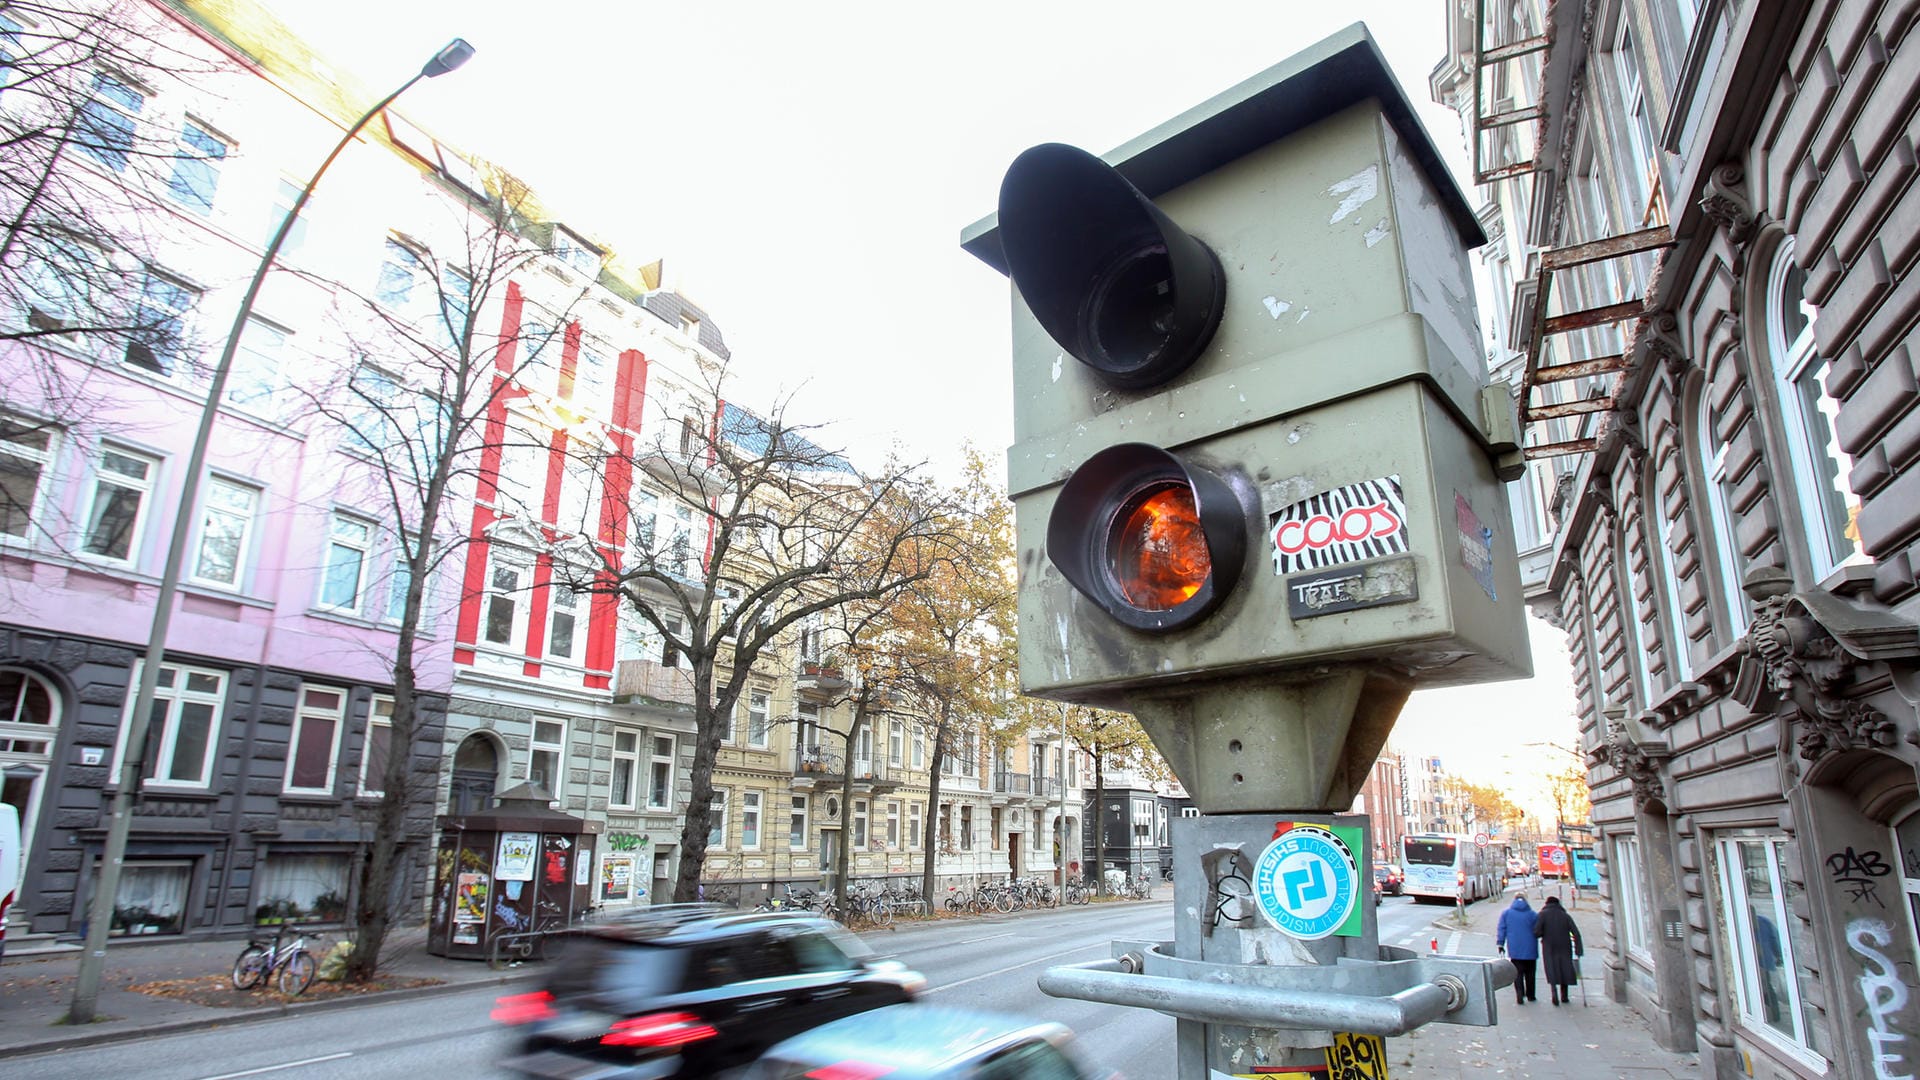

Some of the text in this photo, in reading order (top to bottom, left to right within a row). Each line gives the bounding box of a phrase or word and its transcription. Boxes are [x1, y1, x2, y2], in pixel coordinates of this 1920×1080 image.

[1276, 502, 1398, 553] caos
[1259, 840, 1299, 894] SHISHA
[1302, 840, 1344, 869] ABOUT
[1825, 846, 1891, 877] DAB
[1338, 875, 1349, 899] ALL
[1264, 896, 1316, 932] DUDISM
